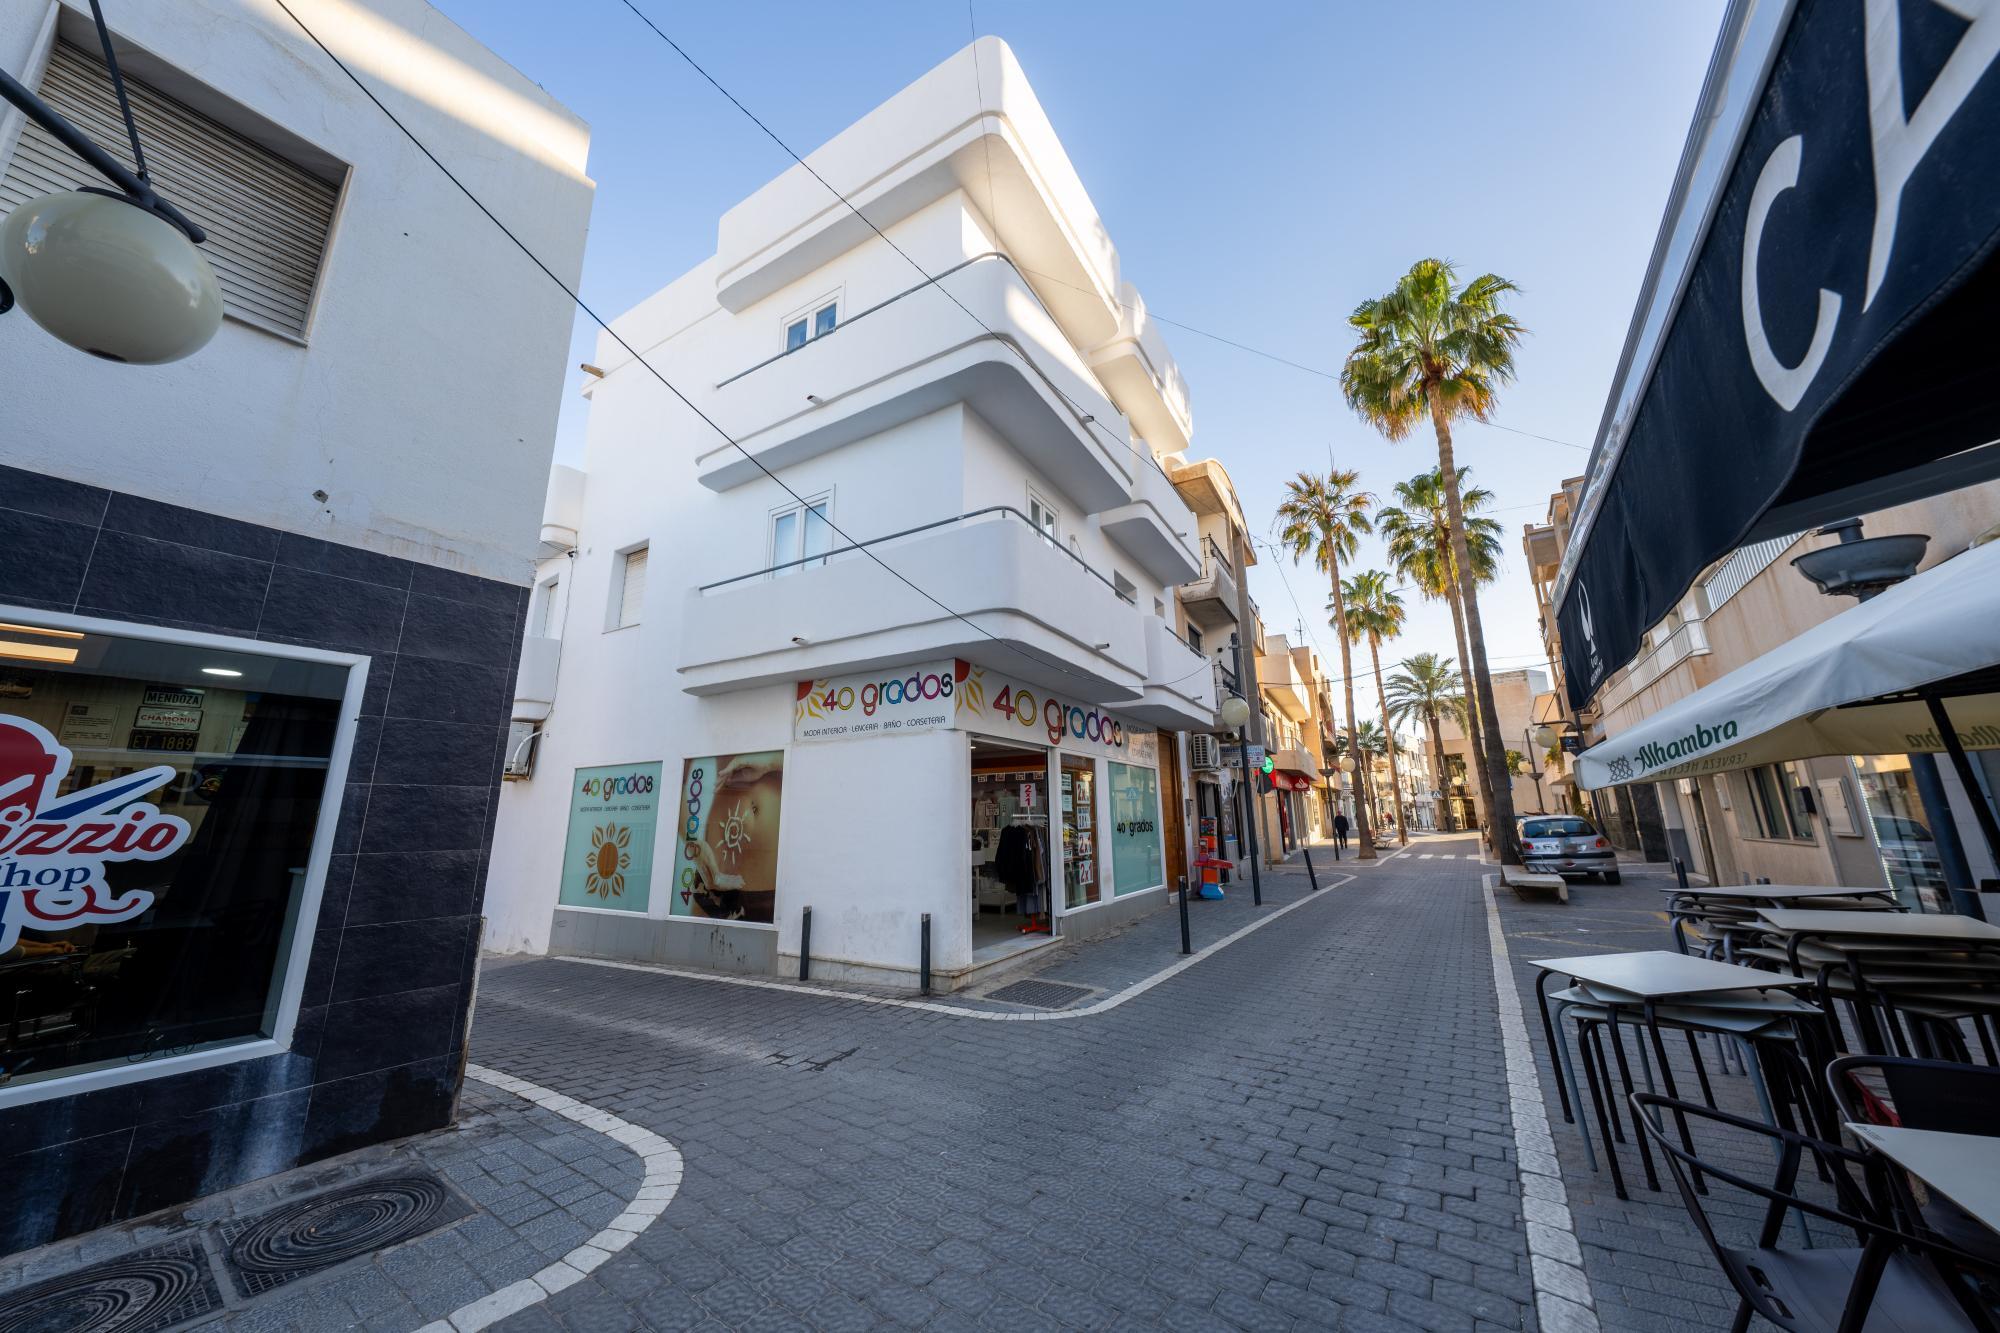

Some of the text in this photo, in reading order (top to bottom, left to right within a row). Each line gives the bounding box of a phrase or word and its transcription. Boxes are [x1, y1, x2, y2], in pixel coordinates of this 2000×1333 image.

[146, 691, 199, 705] MENDOZA
[822, 671, 954, 717] 40 grados
[140, 713, 198, 724] CHAMONIX
[803, 715, 946, 737] MODA INTERIOR LENCERIA BAÑO CORSETERIA
[992, 684, 1123, 748] 40 grados
[1634, 720, 1738, 775] Alhambra
[582, 771, 654, 801] 40 grados
[680, 767, 704, 906] 40 grados
[1116, 818, 1154, 837] 40 grados
[0, 854, 92, 892] hop
[1080, 862, 1093, 883] 2x1
